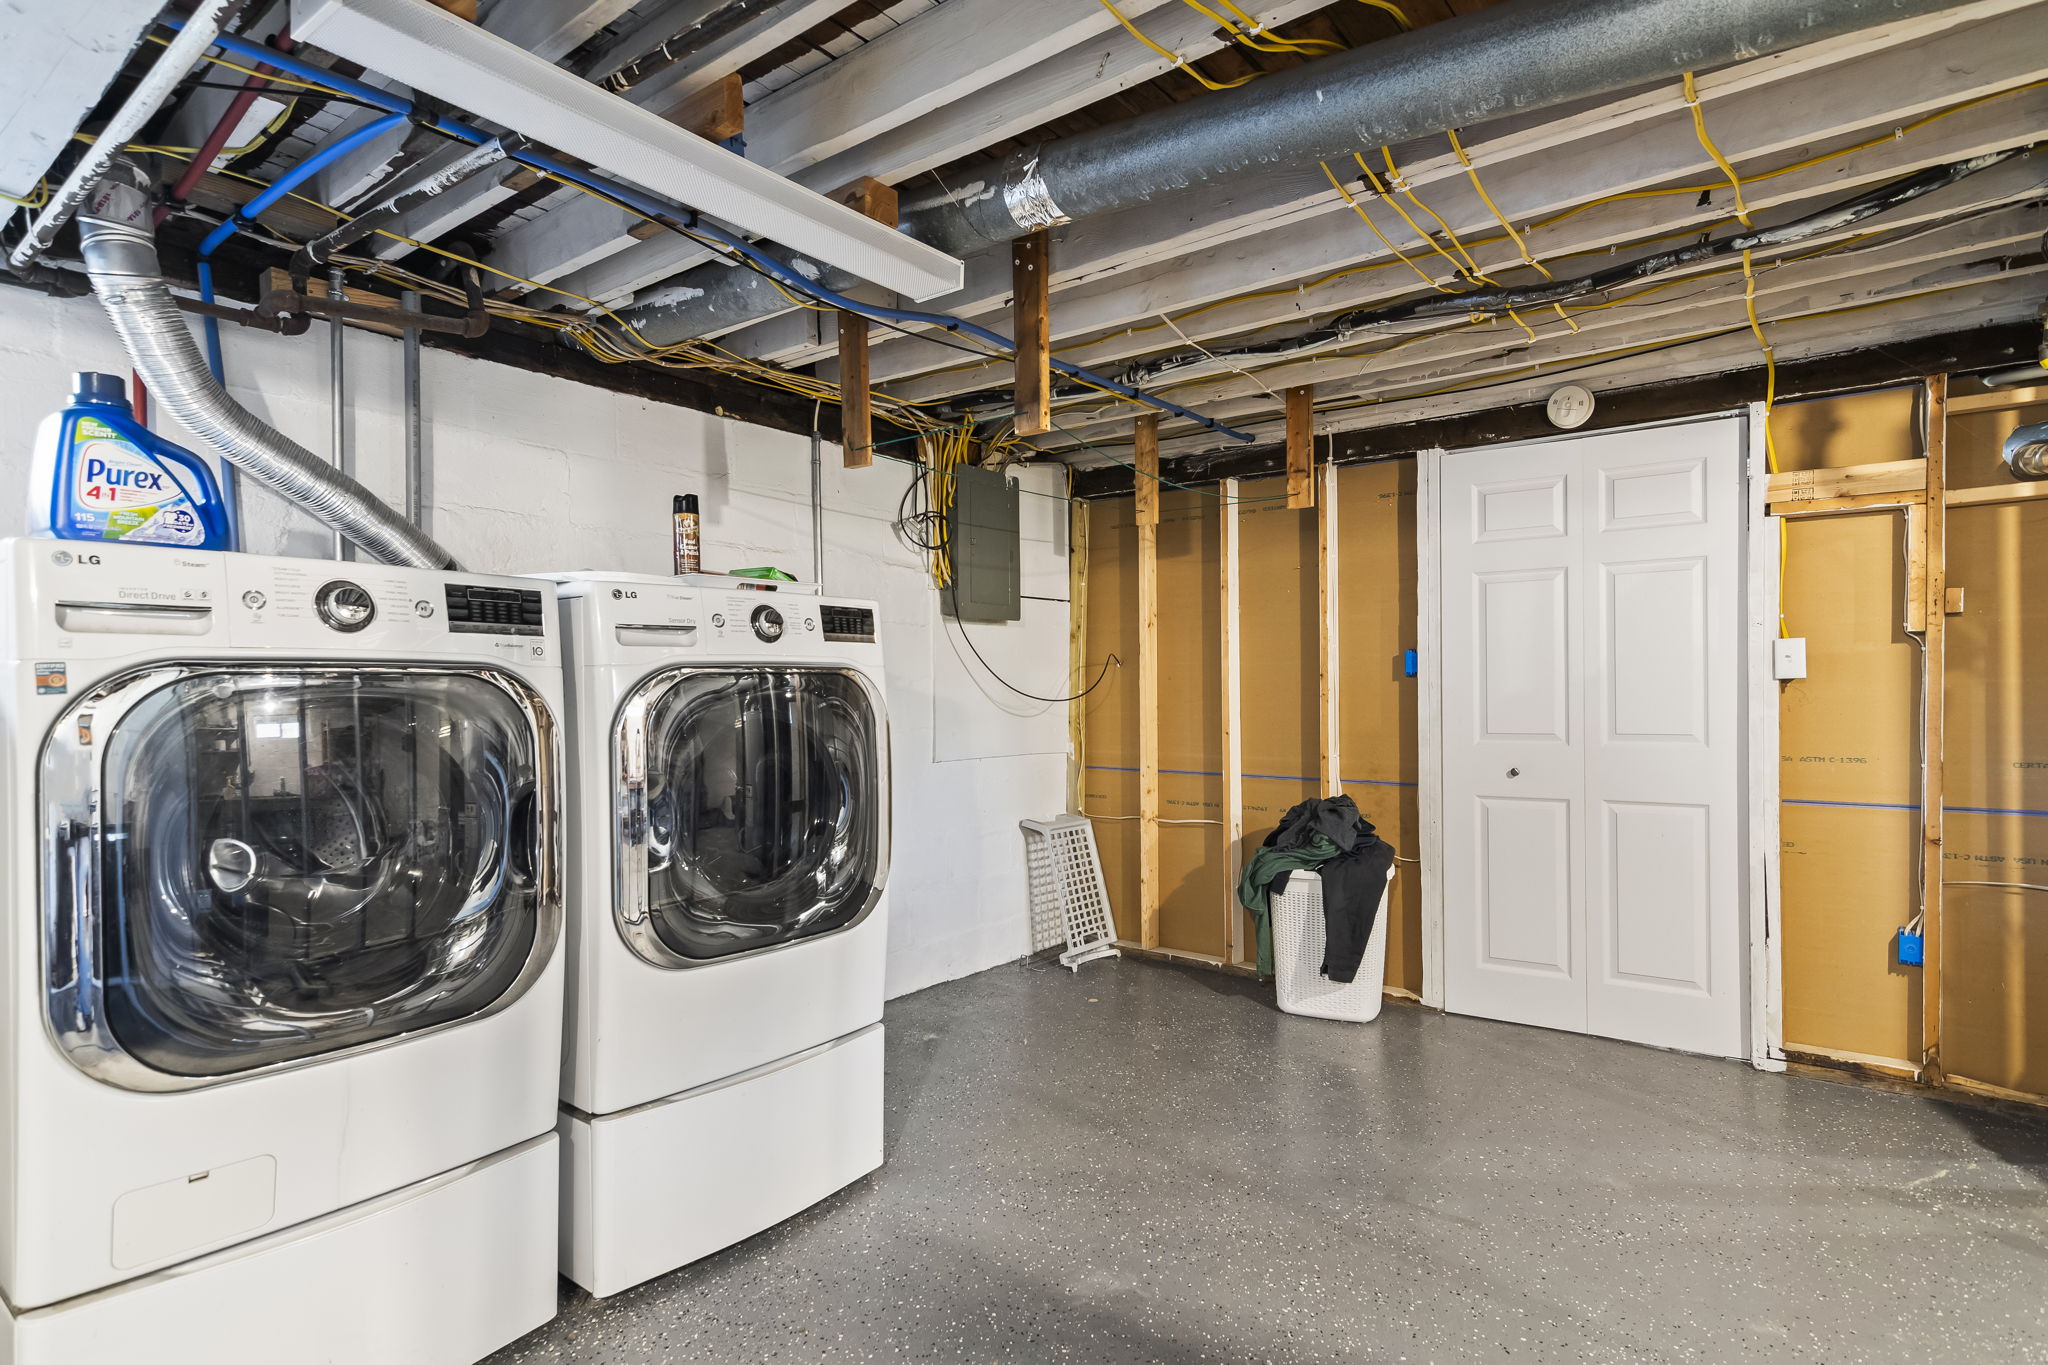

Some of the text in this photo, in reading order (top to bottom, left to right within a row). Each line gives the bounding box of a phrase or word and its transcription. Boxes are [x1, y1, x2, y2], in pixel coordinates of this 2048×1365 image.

[86, 458, 162, 491] Purex
[86, 485, 101, 500] 4
[109, 487, 116, 501] 1
[74, 512, 96, 522] 115
[177, 514, 191, 522] 30
[78, 554, 101, 565] LG
[118, 590, 176, 600] Direct Drive
[625, 591, 638, 599] LG
